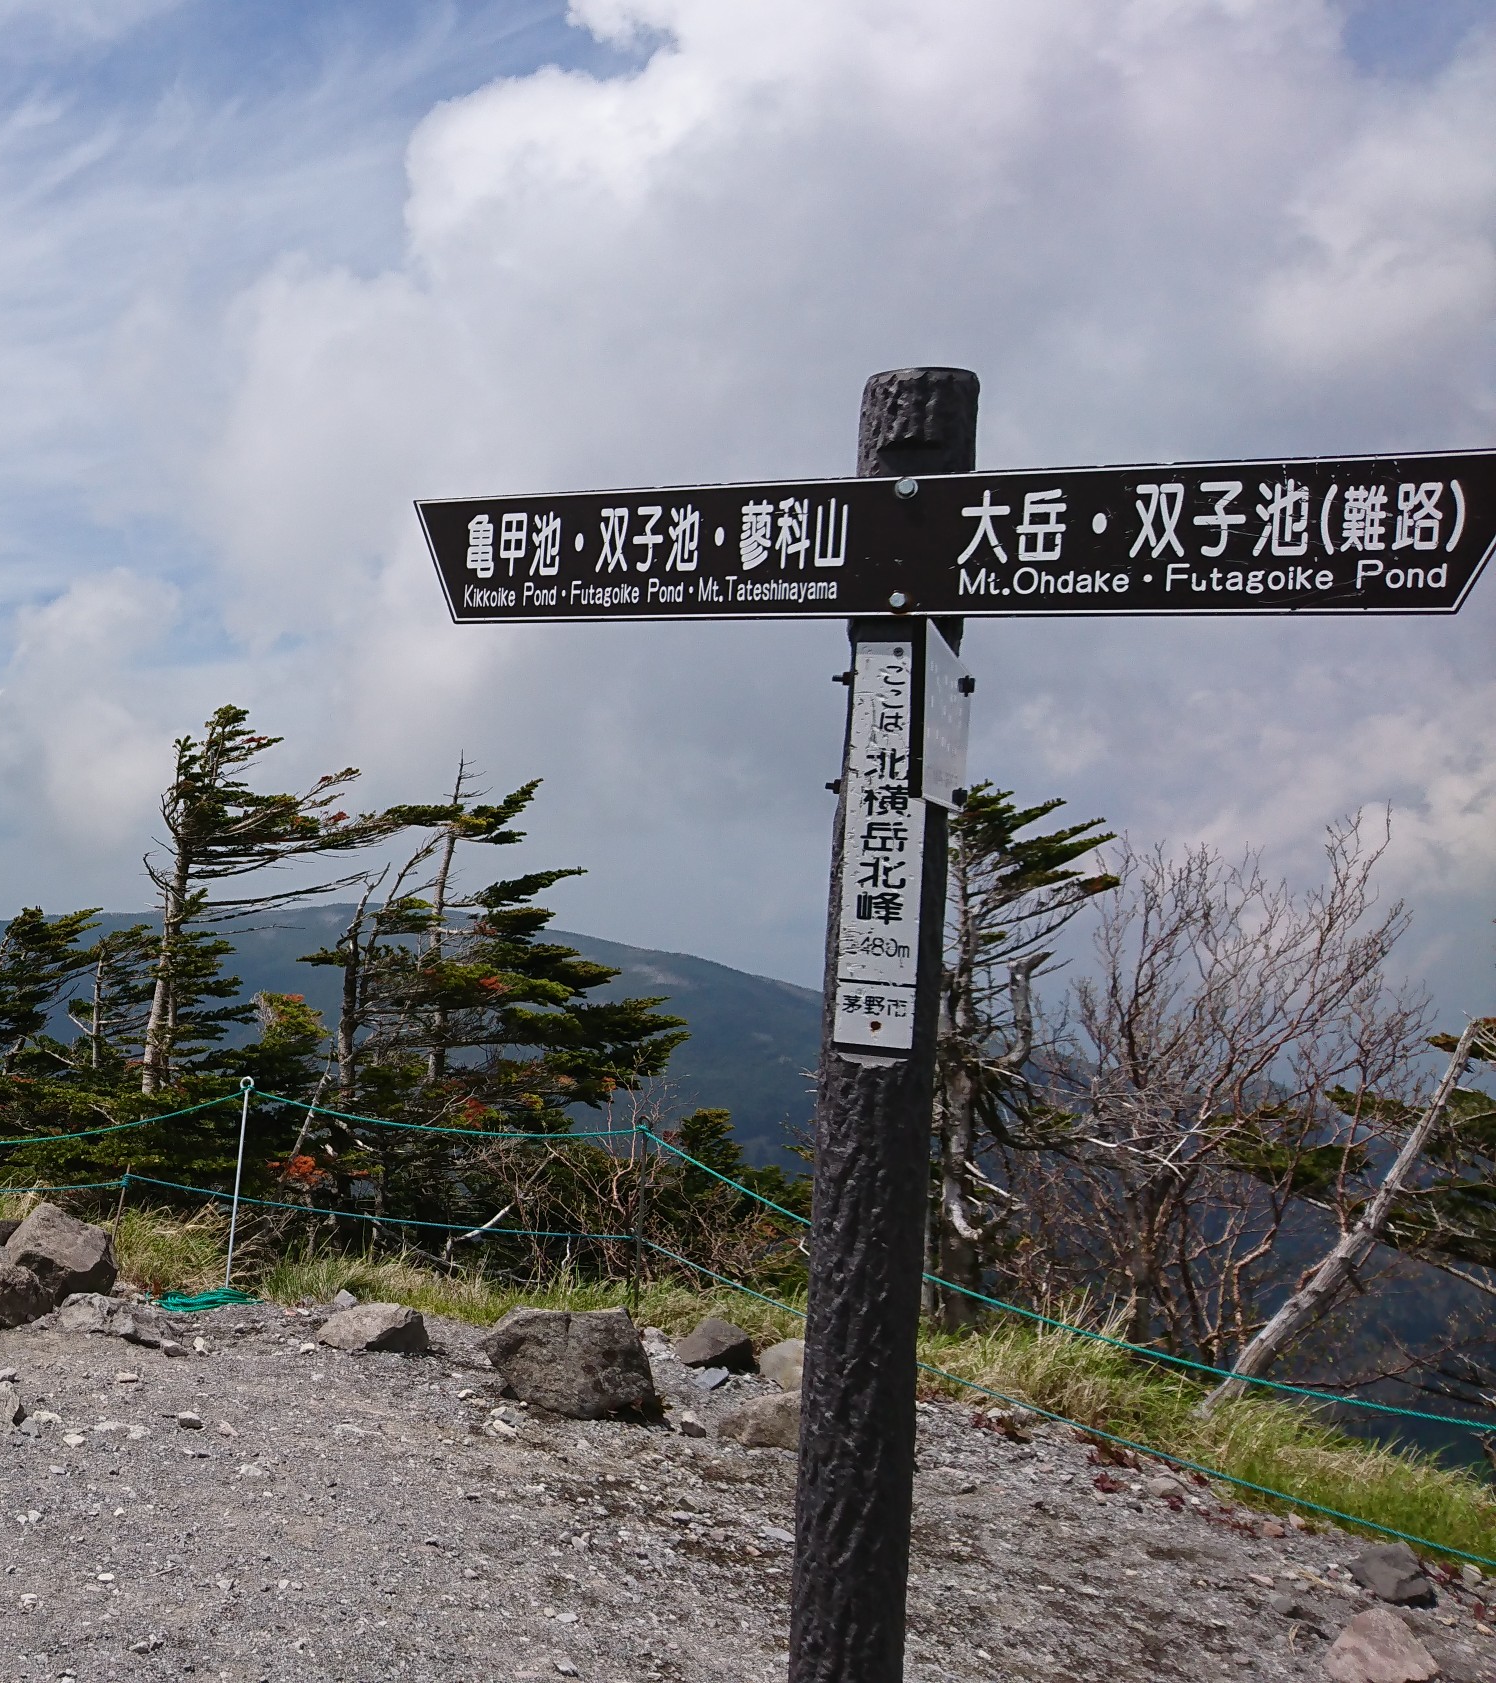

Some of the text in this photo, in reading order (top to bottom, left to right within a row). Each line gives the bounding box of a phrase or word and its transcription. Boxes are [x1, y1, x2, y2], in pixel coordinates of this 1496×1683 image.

[1165, 562, 1334, 592] Futagoike
[1355, 560, 1448, 589] Pond
[464, 584, 516, 607] Kikkoike
[843, 994, 907, 1018] 茅野市
